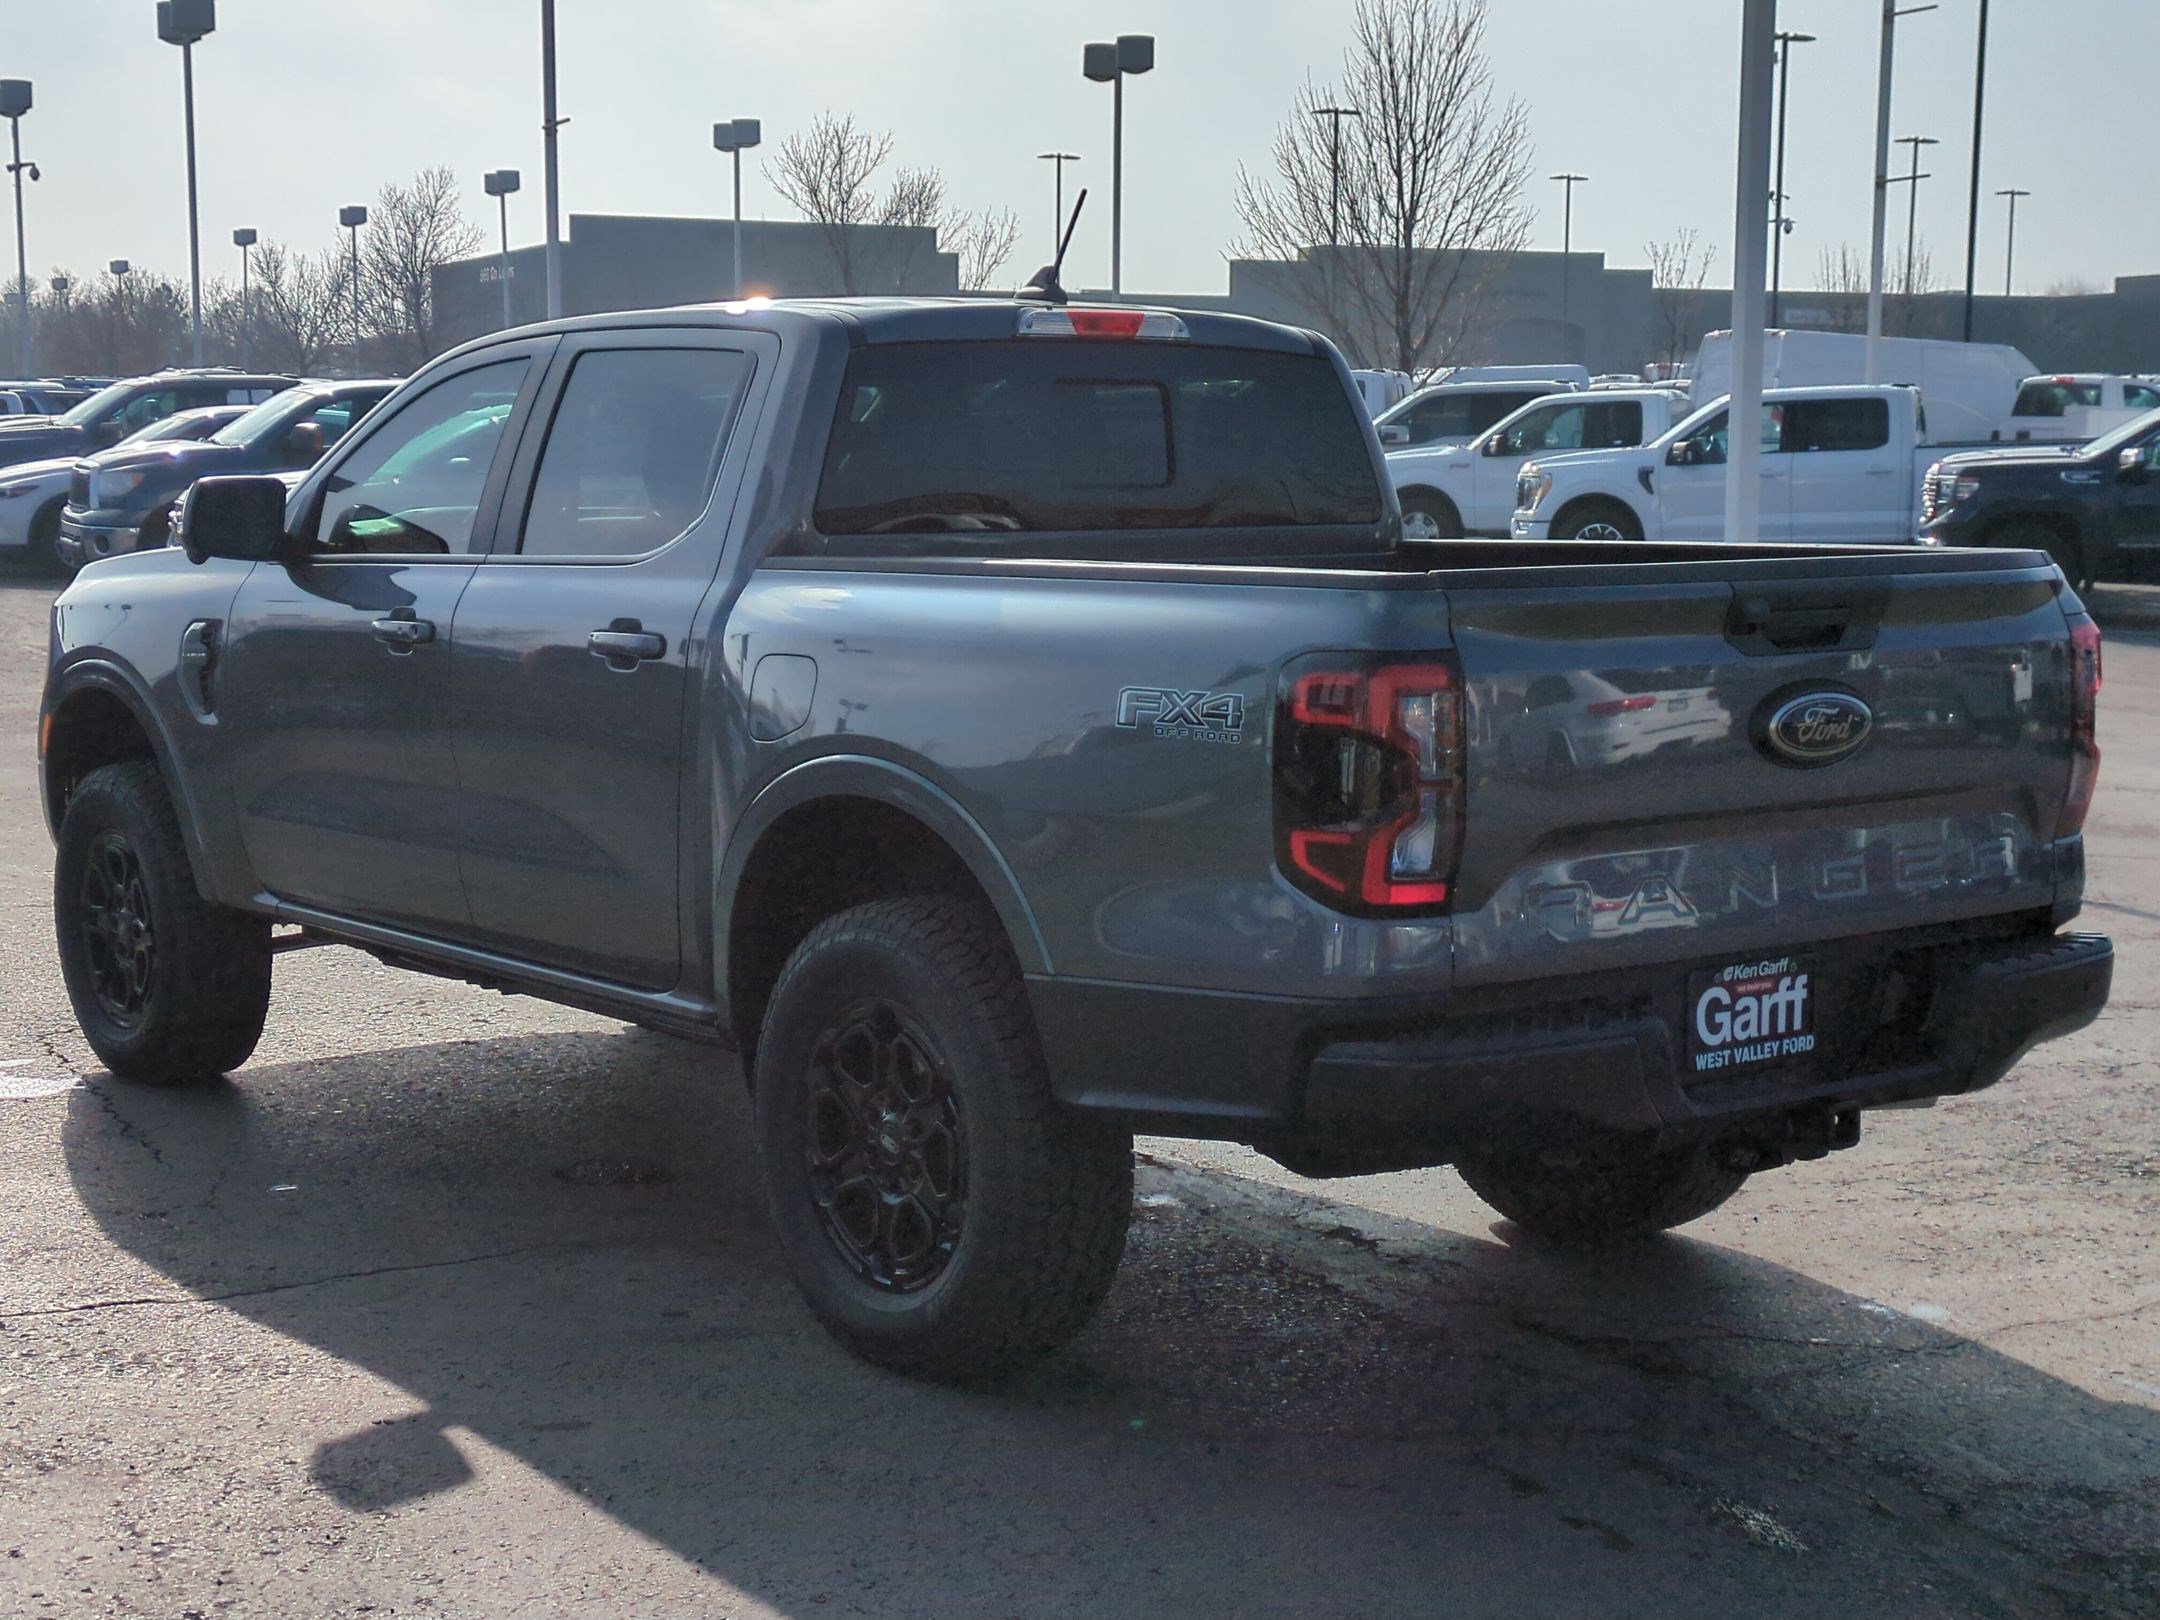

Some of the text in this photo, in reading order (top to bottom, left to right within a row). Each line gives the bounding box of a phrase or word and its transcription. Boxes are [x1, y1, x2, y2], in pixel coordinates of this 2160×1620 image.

[1115, 686, 1245, 731] FX4
[1798, 707, 1853, 743] Ford
[1154, 726, 1242, 744] OFF ROAD
[1526, 834, 2017, 932] RANGER
[1733, 957, 1789, 980] Ken Garff
[1696, 974, 1808, 1046] Garff
[1695, 1035, 1815, 1071] WEST VALLEY FORD
